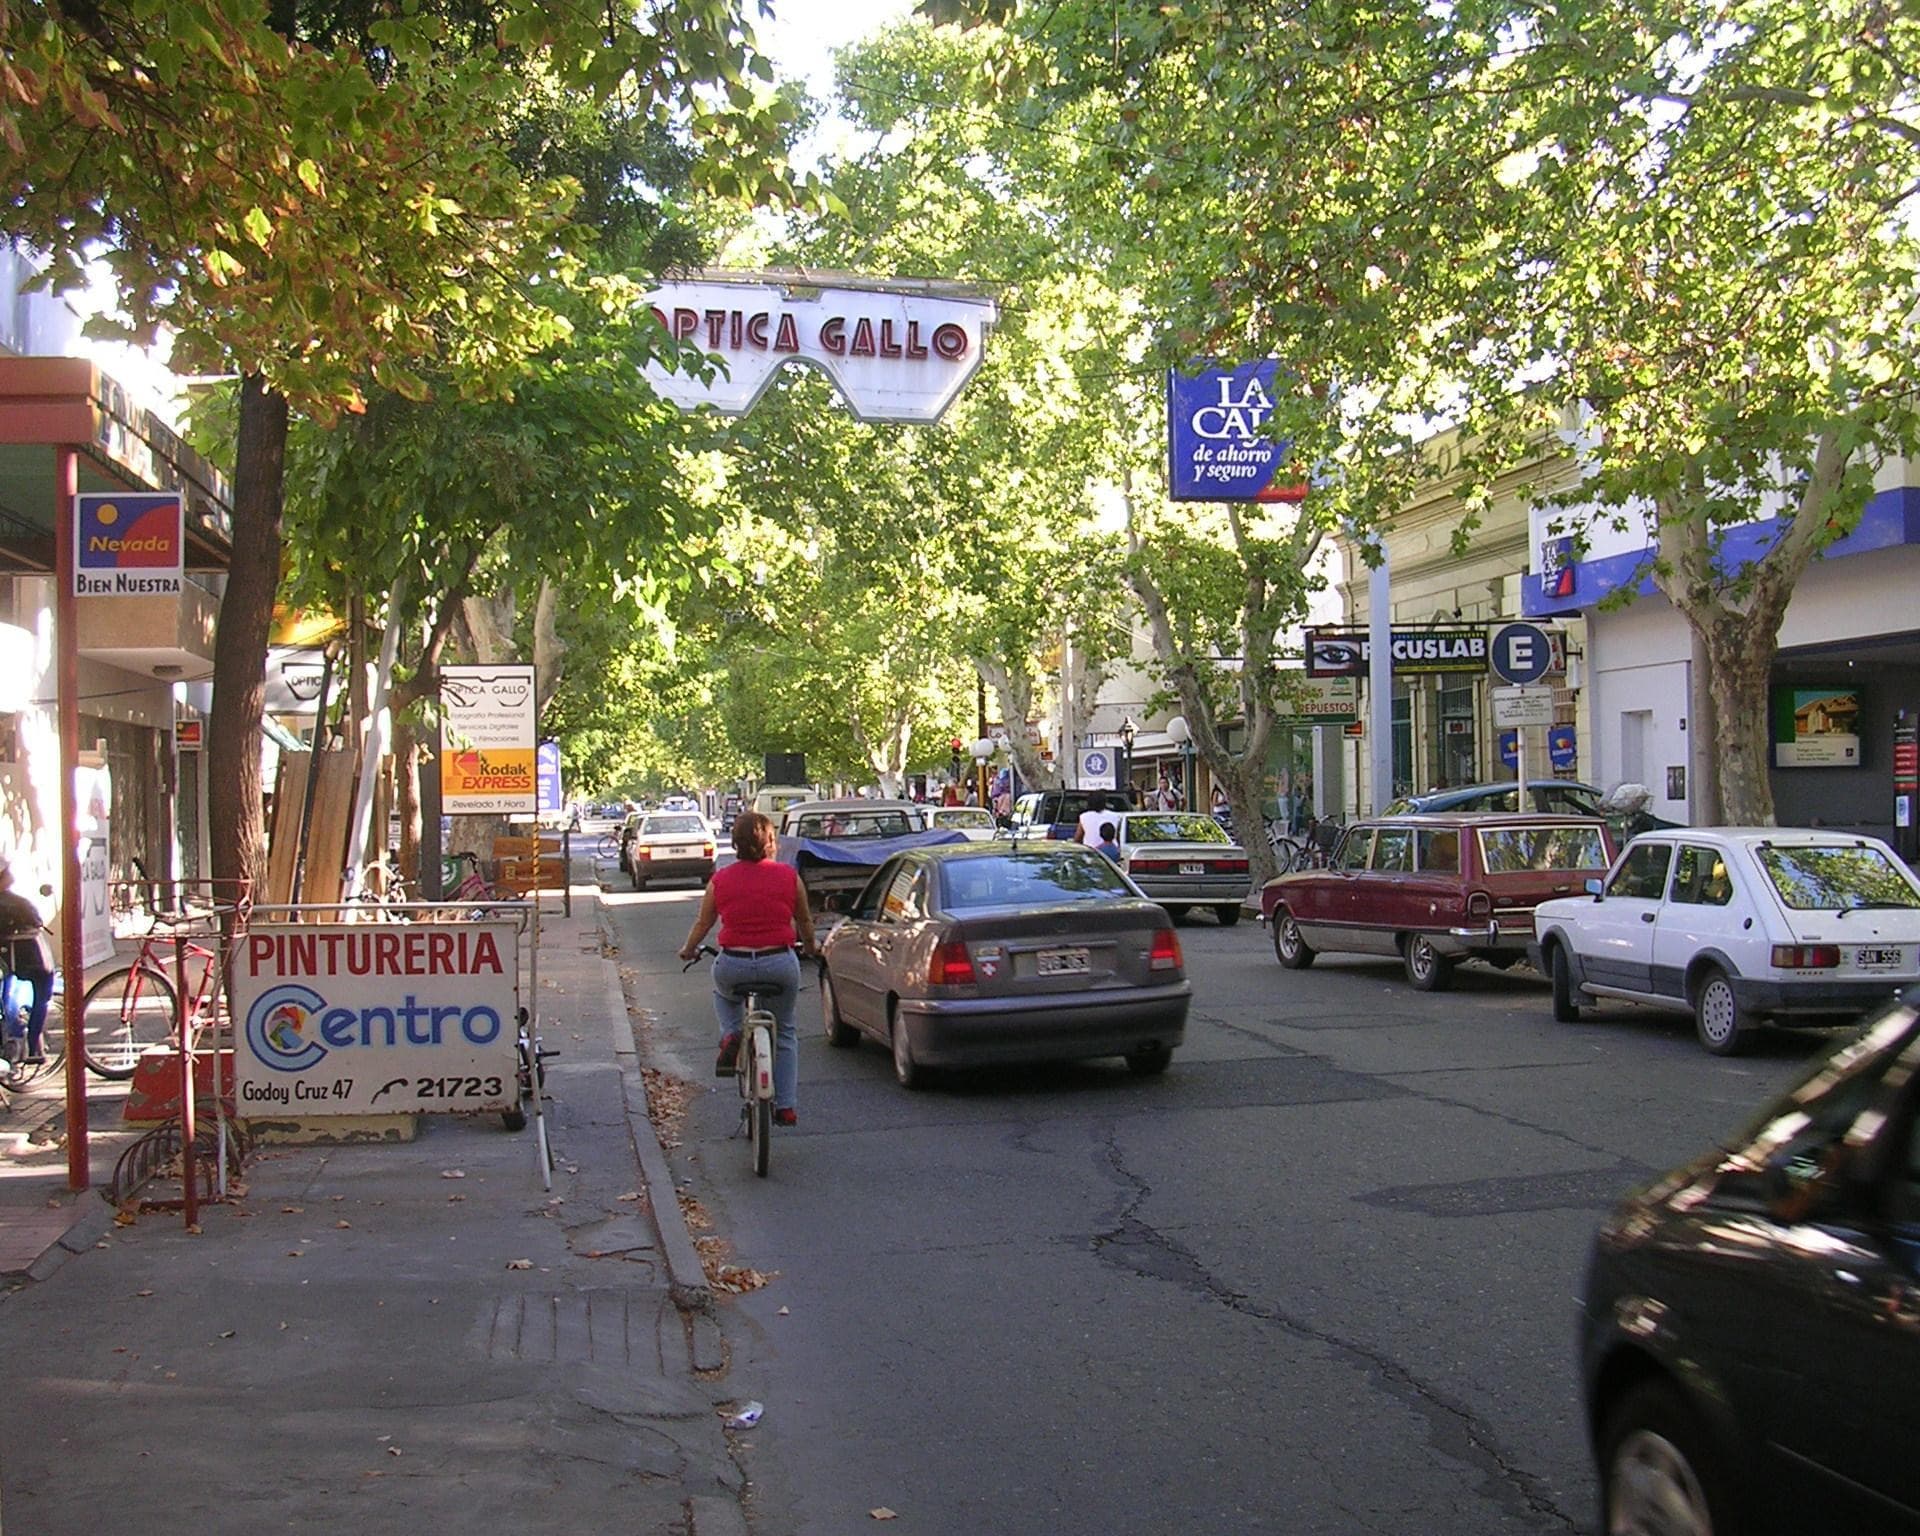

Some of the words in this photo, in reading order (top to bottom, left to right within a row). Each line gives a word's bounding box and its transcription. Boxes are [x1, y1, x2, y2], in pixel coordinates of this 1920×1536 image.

[820, 317, 968, 360] GALLO
[1217, 377, 1273, 408] LA
[1192, 407, 1272, 447] CAJ
[1193, 443, 1213, 461] de
[1217, 444, 1271, 462] ahorro
[1193, 464, 1205, 482] y
[1206, 464, 1257, 482] seguro
[89, 536, 170, 552] Nevada
[77, 573, 112, 593] BIEN
[116, 573, 180, 593] NUESTRA
[1361, 638, 1485, 661] FCUSLAB
[1509, 636, 1533, 669] E
[291, 676, 326, 686] OPTIC
[492, 684, 526, 694] GALLO
[489, 723, 519, 731] Digitales
[481, 763, 527, 775] Kodak
[462, 776, 531, 789] EXPRESS
[453, 799, 494, 809] Revelado
[504, 800, 526, 809] Hora
[250, 932, 503, 977] PINTURERIA
[246, 984, 500, 1072] Centro
[243, 1080, 289, 1104] Godoy
[295, 1080, 327, 1100] Cruz
[332, 1079, 353, 1099] 47
[417, 1077, 502, 1098] 21723
